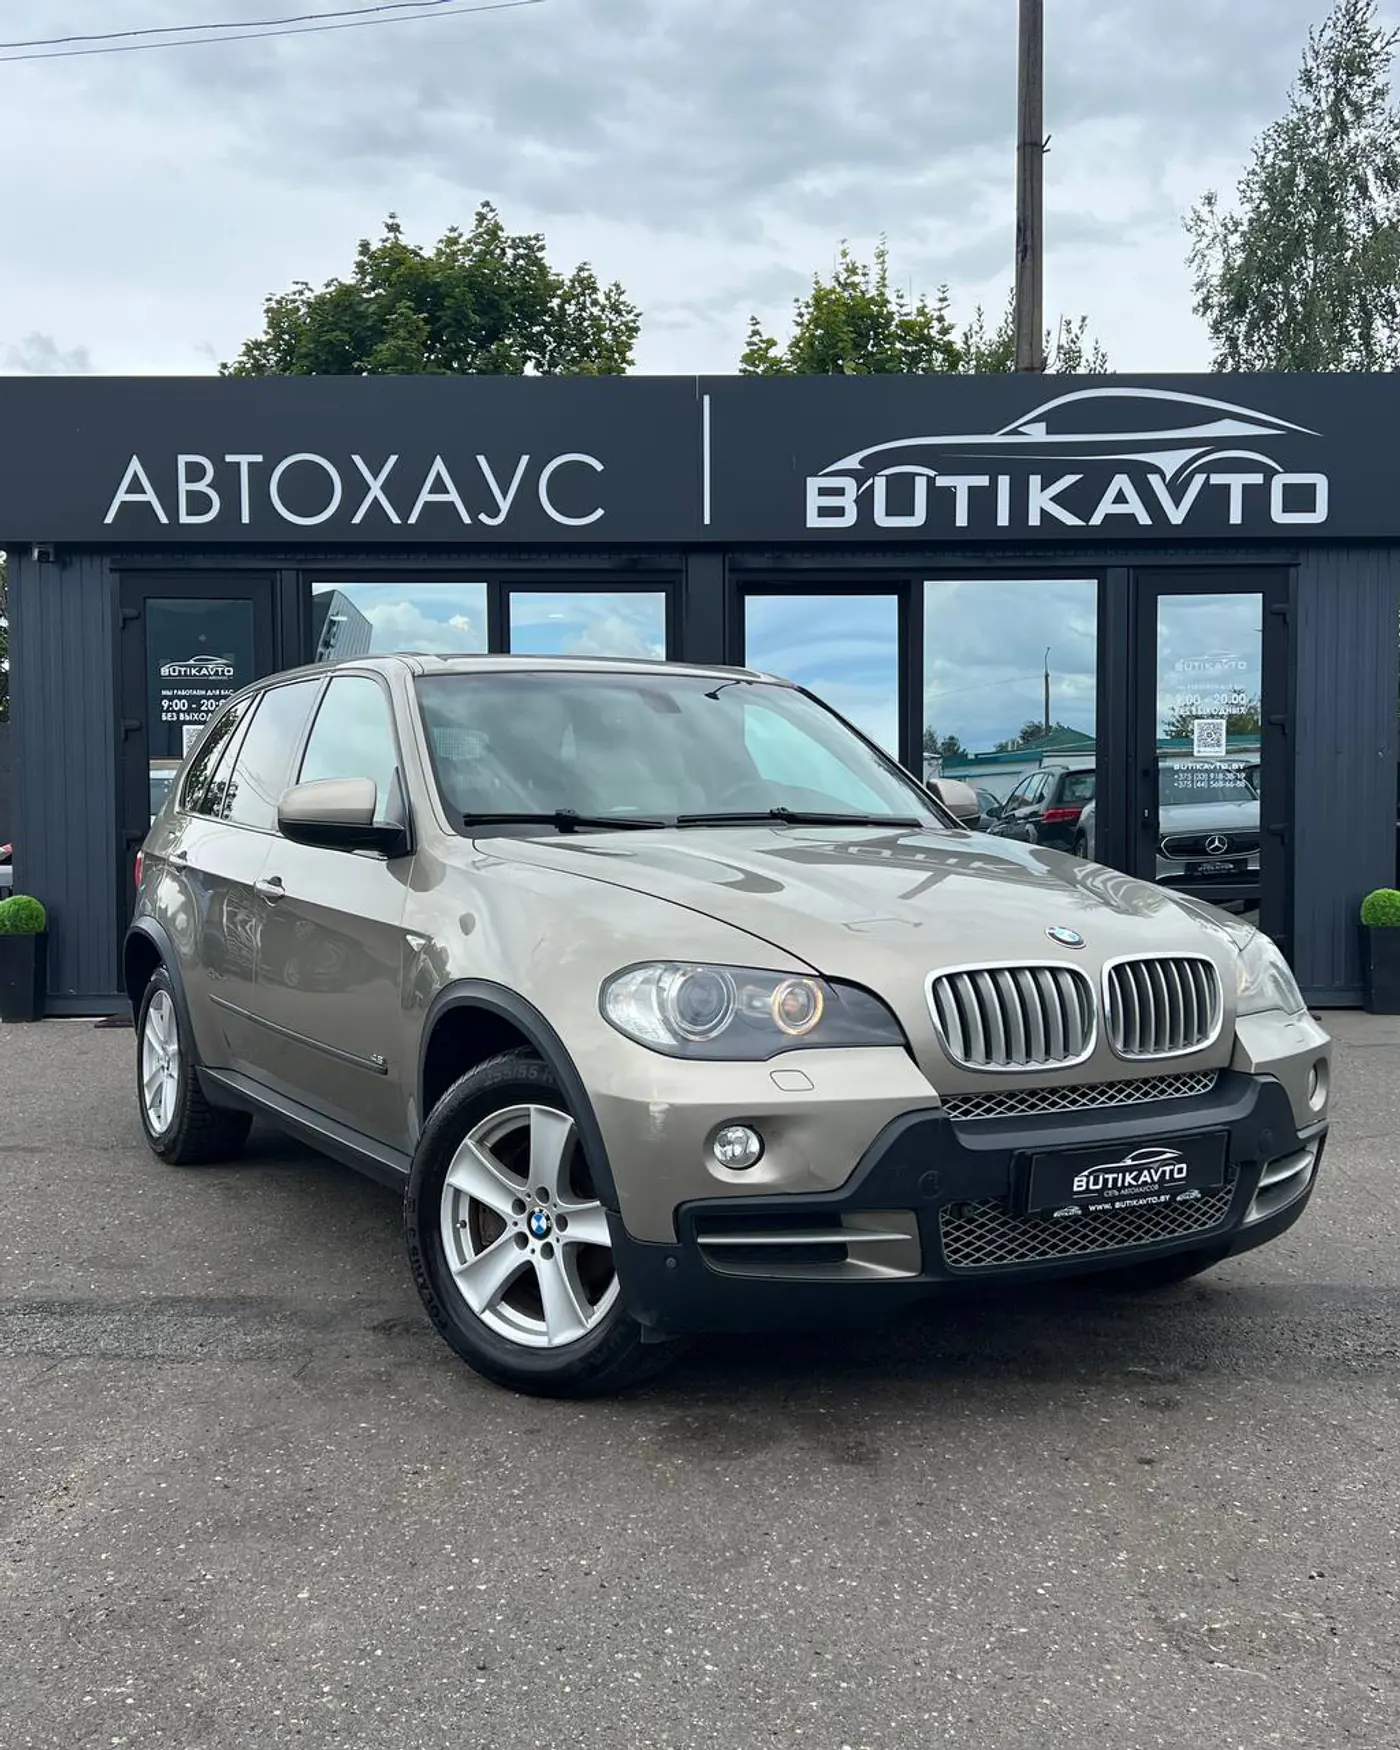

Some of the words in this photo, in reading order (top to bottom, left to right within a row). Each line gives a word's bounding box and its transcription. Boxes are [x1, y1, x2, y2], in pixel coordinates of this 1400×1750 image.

[103, 452, 605, 527] АВТОХАУС
[805, 472, 1329, 528] BUTIKAVTO
[160, 666, 234, 677] BUTIKAVTO
[161, 699, 188, 711] 9:00
[161, 712, 177, 721] БЕЗ
[1072, 1163, 1188, 1192] BUTIKAVTO
